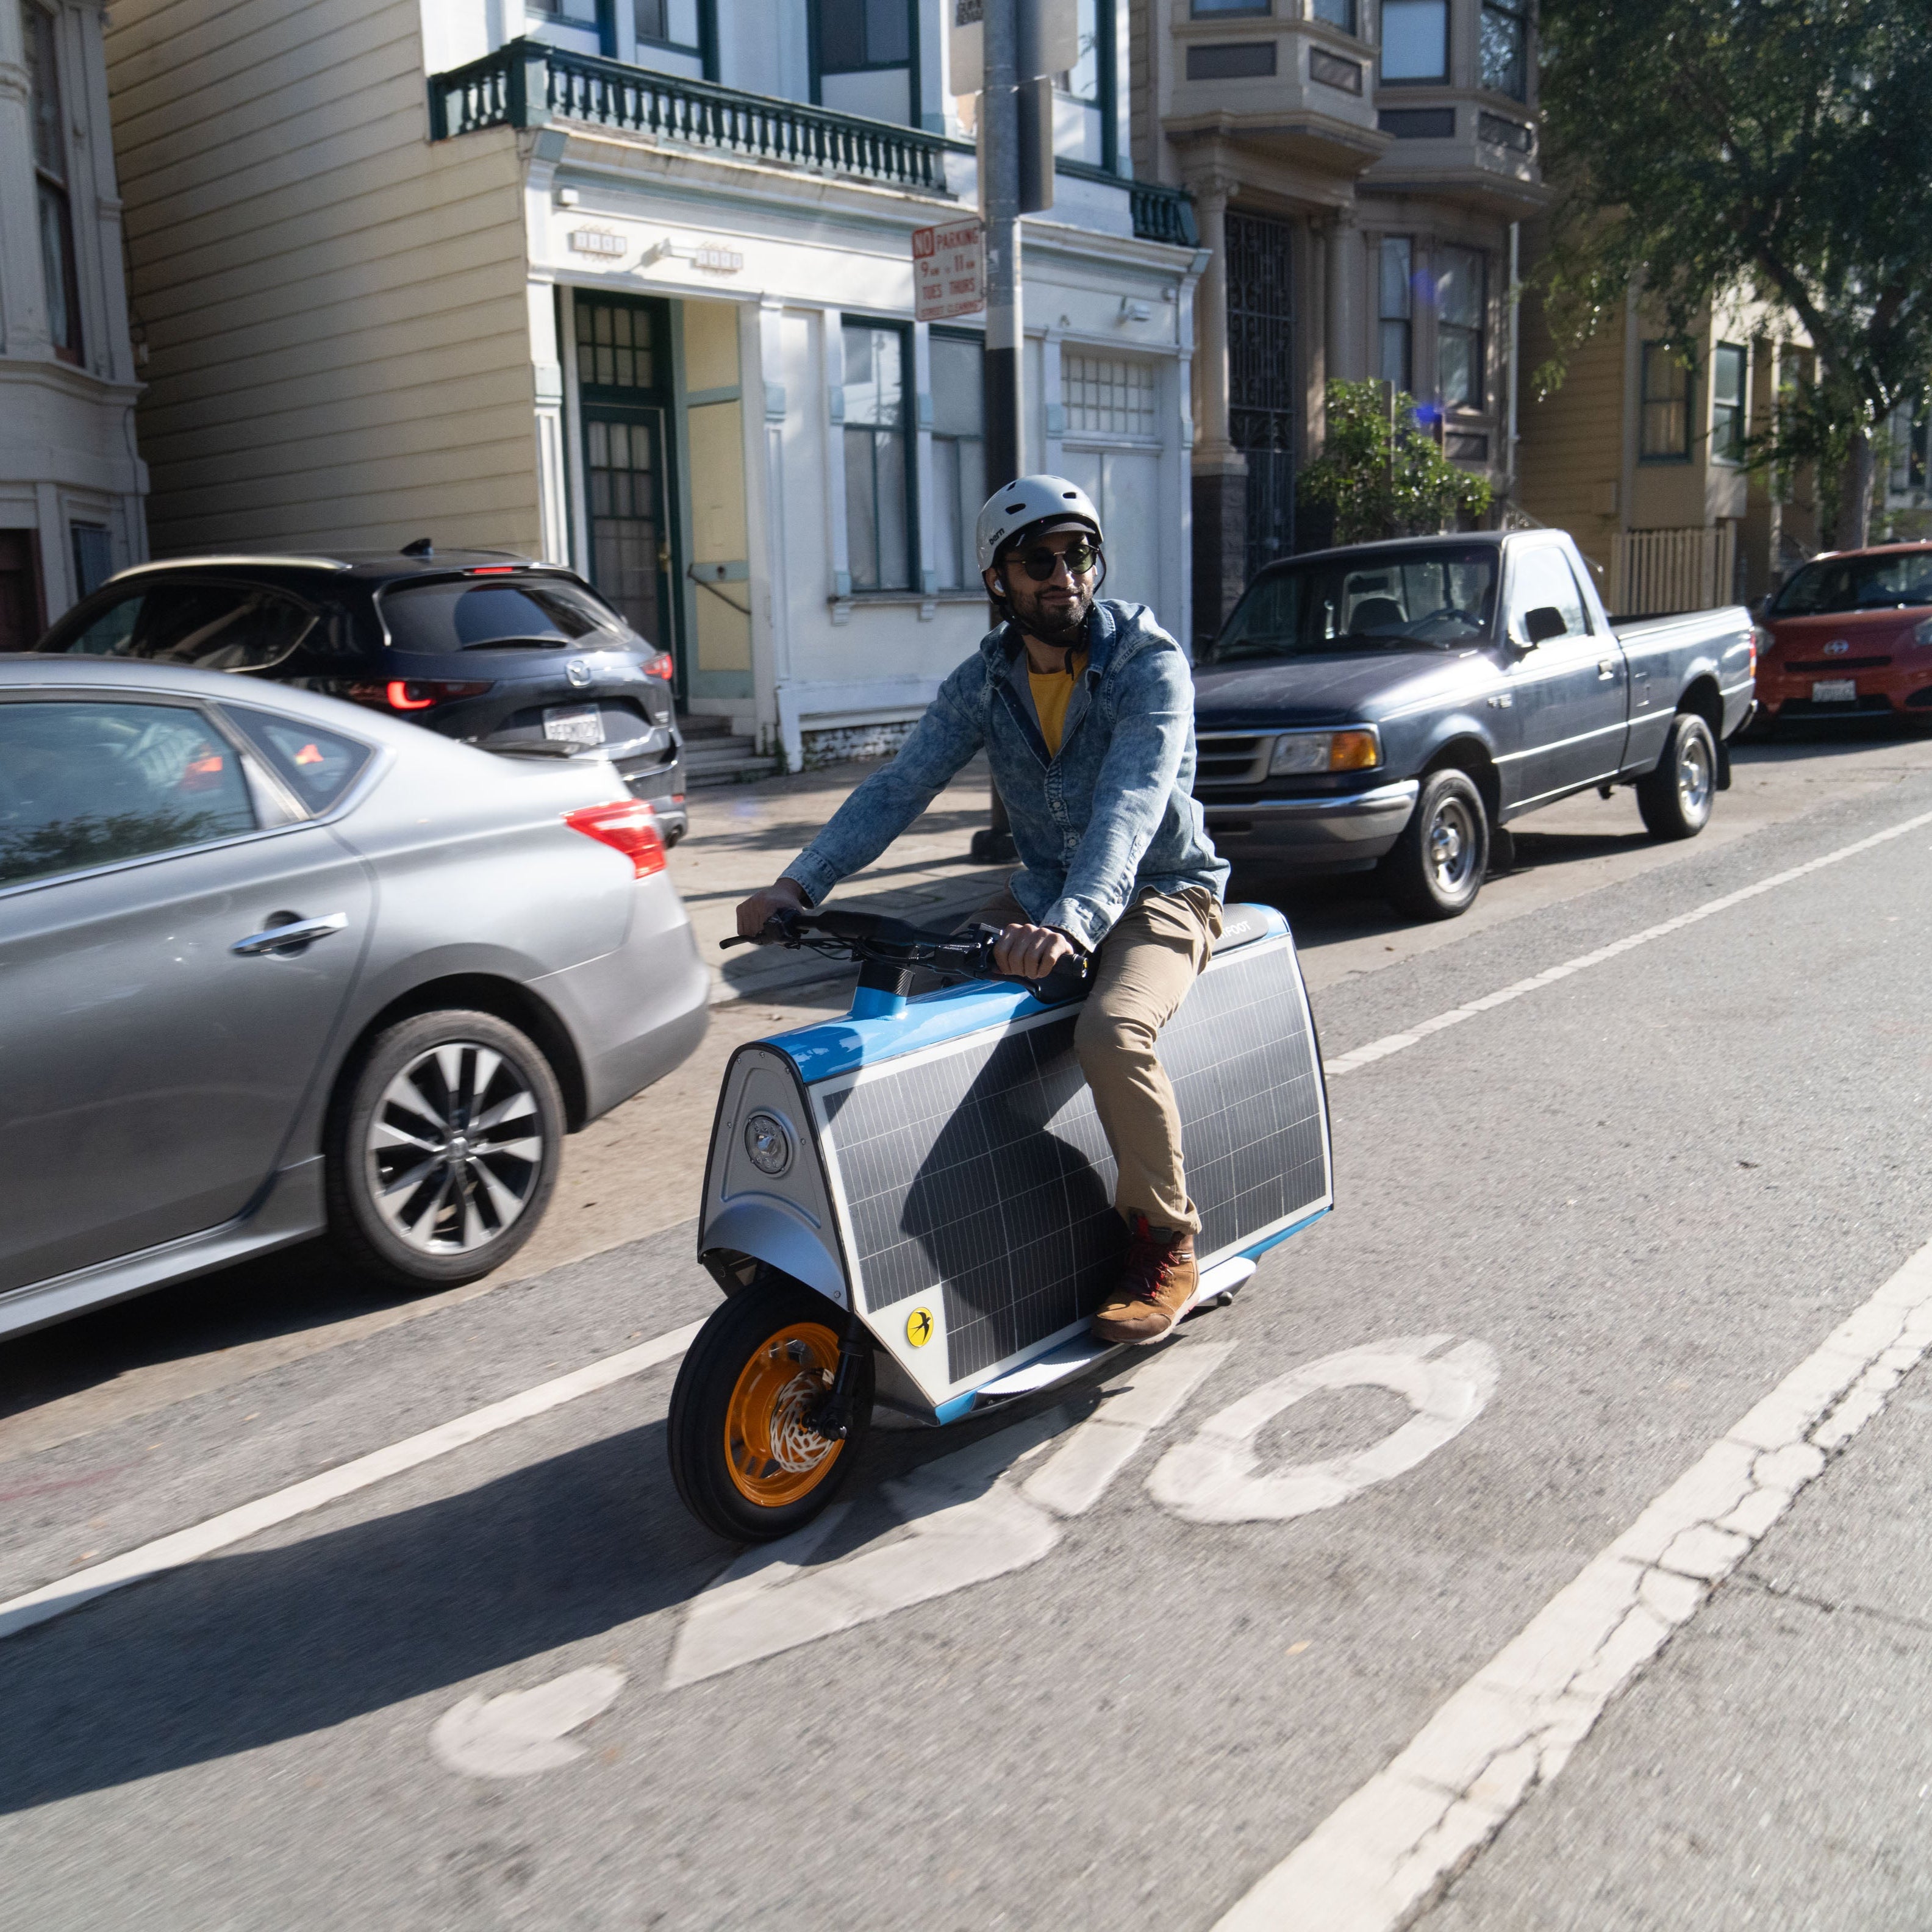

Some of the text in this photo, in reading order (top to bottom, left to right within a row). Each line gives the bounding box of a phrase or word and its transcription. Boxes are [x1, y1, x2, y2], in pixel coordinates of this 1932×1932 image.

[915, 227, 979, 256] NO PARKING
[921, 261, 928, 277] 9
[954, 255, 963, 271] 11
[922, 277, 975, 300] TUES THURS
[989, 528, 1004, 545] bern
